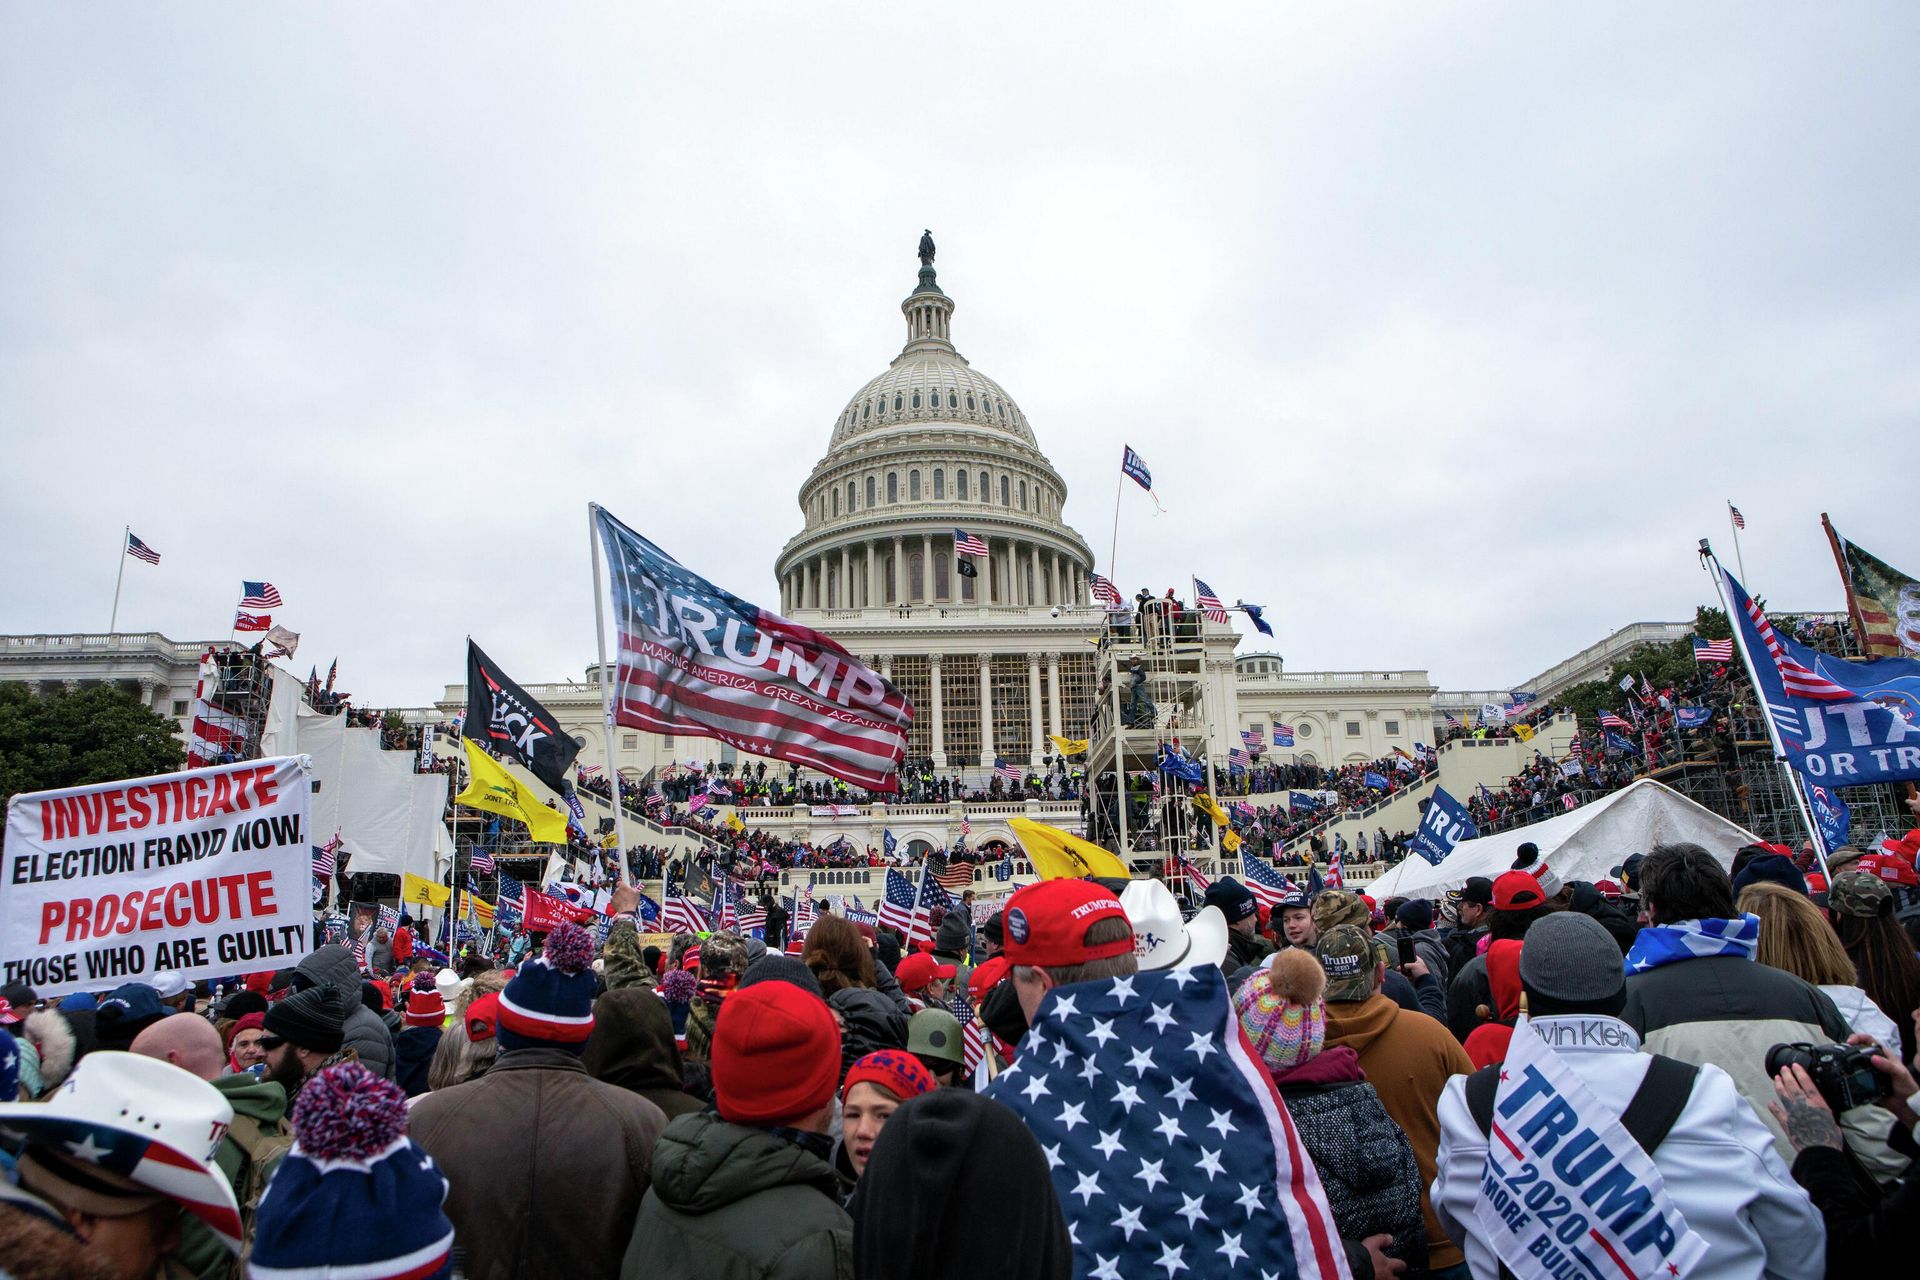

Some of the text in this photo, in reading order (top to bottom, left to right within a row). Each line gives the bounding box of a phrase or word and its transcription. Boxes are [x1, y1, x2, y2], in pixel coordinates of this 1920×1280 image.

[641, 575, 885, 707] TRUMP
[641, 641, 888, 730] MAKING AMERICA GREAT AGAIN!
[422, 727, 433, 767] TRUMP
[1805, 752, 1858, 776] OR
[40, 765, 279, 841] INVESTIGATE
[570, 793, 584, 818] TRUMP
[12, 814, 304, 885] ELECTION FRAUD NOW.
[38, 870, 278, 945] PROSECUTE
[846, 911, 877, 925] TRUMP
[1071, 900, 1108, 919] TRUMP
[3, 925, 304, 987] THOSE WHO ARE GUILTY
[1322, 954, 1359, 966] Trump
[1581, 1020, 1629, 1047] Klein
[1497, 1064, 1676, 1258] TRUMP
[1482, 1174, 1531, 1234] MORE
[1504, 1162, 1589, 1245] 2020
